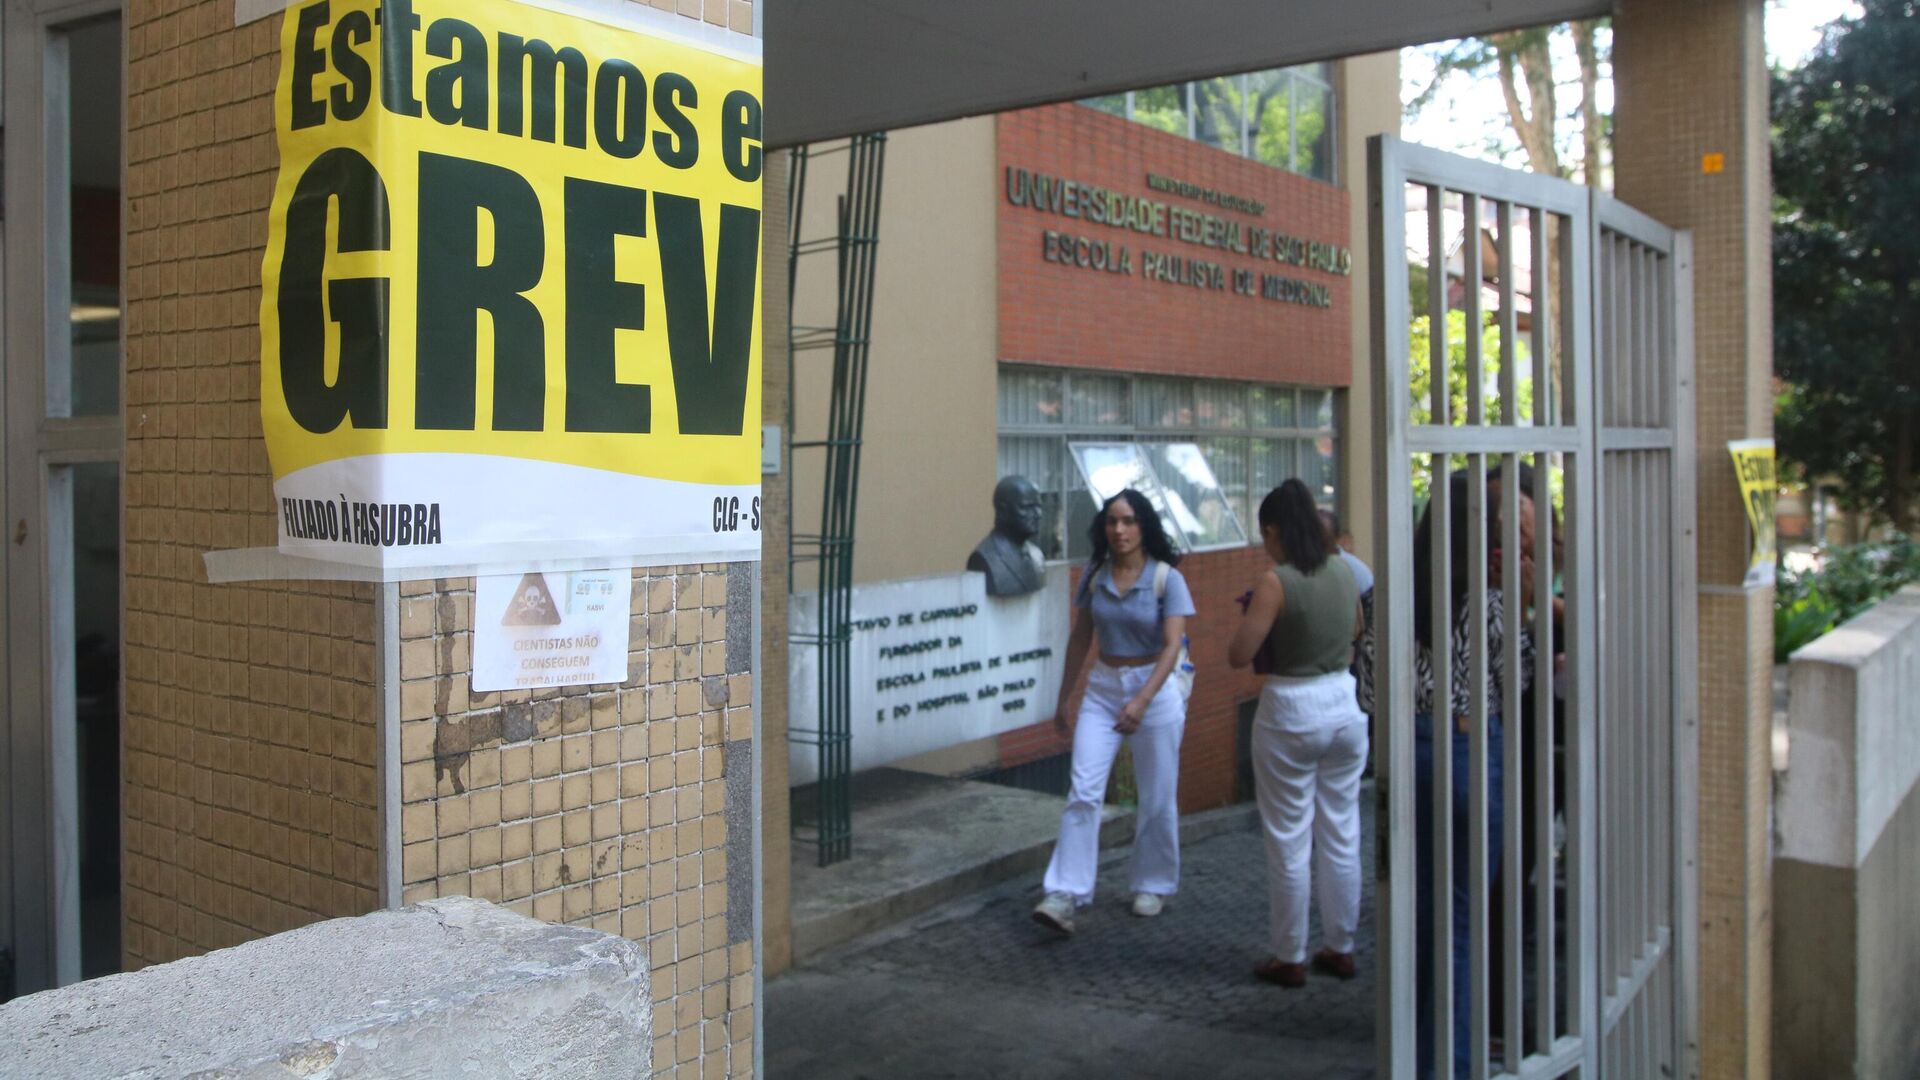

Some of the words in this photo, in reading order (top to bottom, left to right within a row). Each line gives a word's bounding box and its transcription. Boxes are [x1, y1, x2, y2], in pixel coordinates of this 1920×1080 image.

[291, 0, 700, 170] Estamos
[721, 89, 761, 183] e
[1006, 165, 1166, 236] UNIVERSIDADE
[1167, 204, 1248, 253] FEDERAL
[1249, 224, 1272, 259] DE
[1307, 240, 1351, 276] PAULO
[1044, 230, 1133, 275] ESCOLA
[1143, 251, 1225, 292] PAULISTA
[1232, 268, 1257, 297] DE
[1262, 273, 1331, 308] MEDICINA
[277, 147, 761, 436] GREV
[282, 497, 339, 542] FILIADO
[340, 493, 352, 543] À
[352, 502, 442, 547] FASUBRA
[713, 496, 739, 533] CLG
[898, 613, 913, 626] DE
[921, 604, 978, 623] CARVALHO
[513, 638, 573, 652] CIENTISTAS
[575, 634, 599, 648] NÃO
[521, 655, 590, 670] CONSEGUEM
[880, 638, 942, 659] FUNDADOR
[948, 636, 963, 648] DA
[877, 672, 925, 692] ESCOLA
[932, 661, 982, 679] PAULISTA
[988, 656, 1001, 669] DE
[1008, 647, 1052, 663] MEDICINA
[877, 709, 885, 722] E
[893, 704, 911, 719] DO
[917, 693, 969, 711] HOSPITAL
[977, 684, 999, 700] SÃO
[1003, 678, 1036, 693] PAULO
